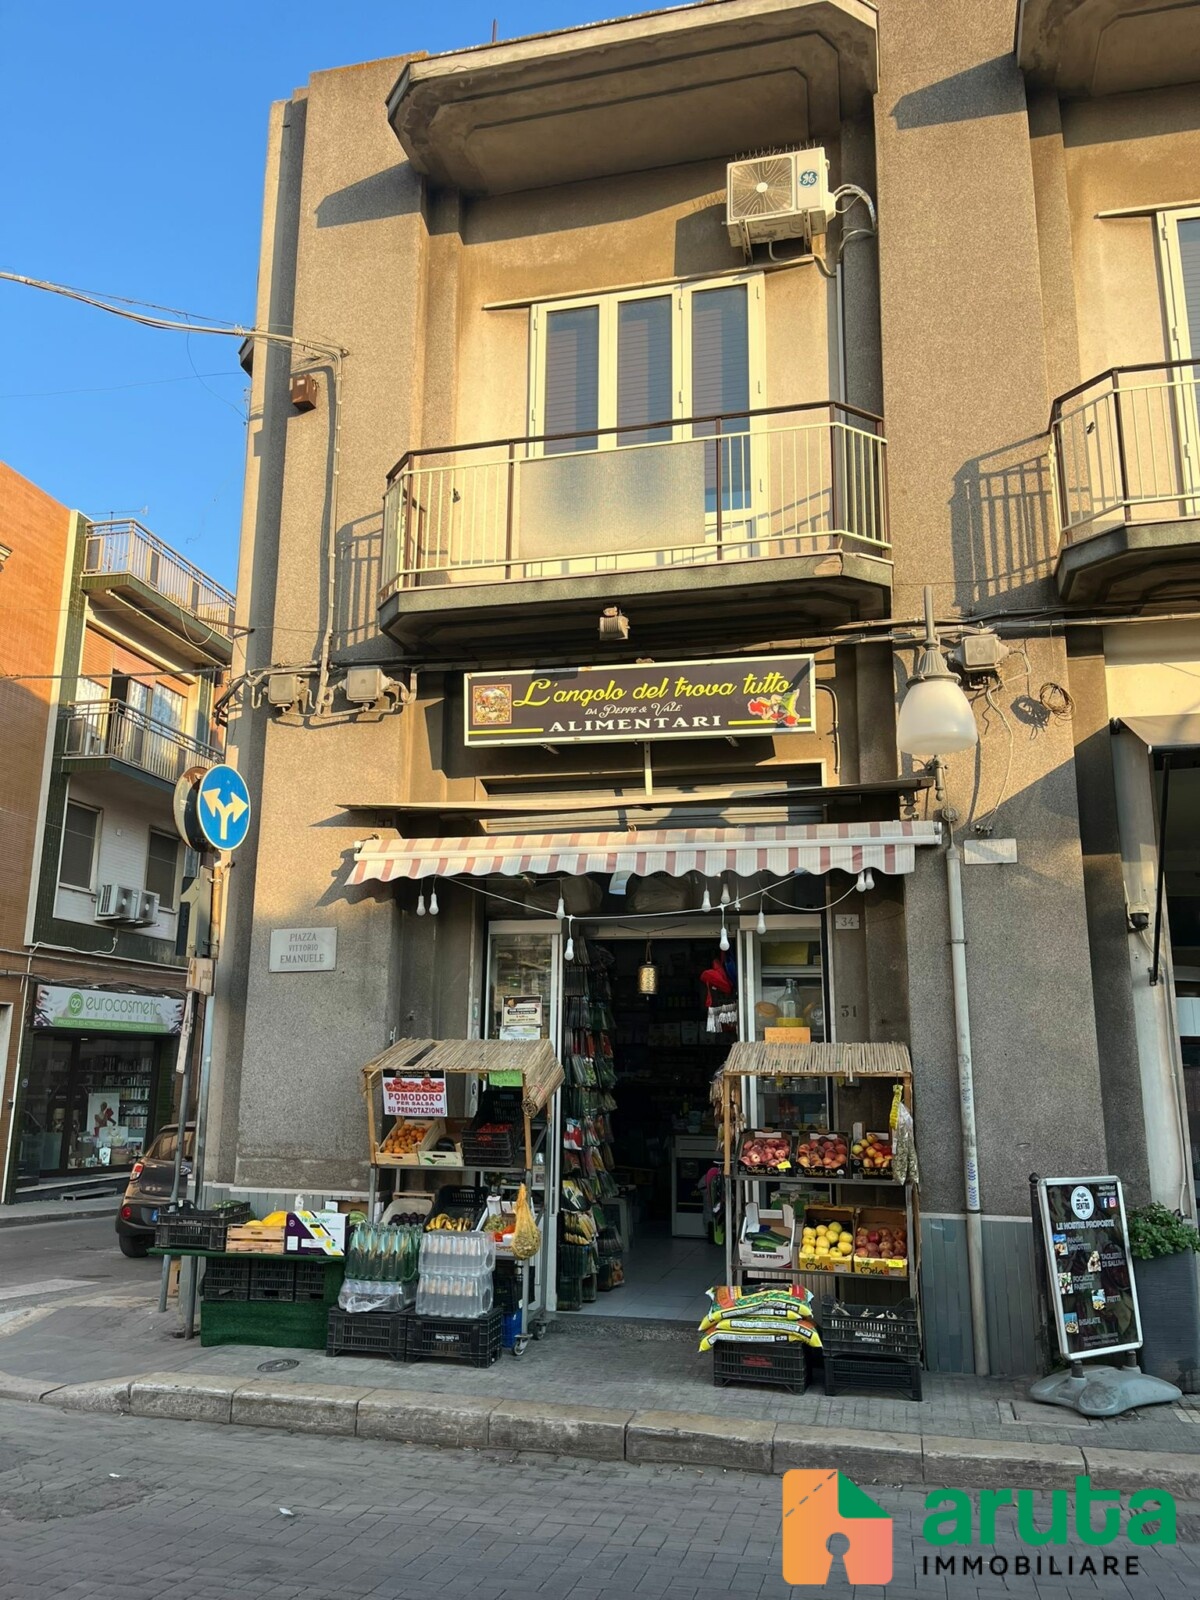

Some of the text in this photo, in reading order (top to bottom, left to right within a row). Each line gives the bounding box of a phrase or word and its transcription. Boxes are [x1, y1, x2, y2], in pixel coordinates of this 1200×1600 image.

[513, 672, 792, 706] L'angolo del trova tutto
[549, 716, 722, 732] ALIMENTARI
[841, 917, 854, 926] 34
[290, 932, 317, 942] PIAZZA
[288, 944, 318, 952] VITTORIO
[280, 954, 324, 964] EMANUELE
[86, 996, 161, 1016] eurocosmetic
[388, 1093, 442, 1102] POMODORO
[1086, 1220, 1115, 1229] PROPOSTE
[806, 1262, 828, 1271] Mela
[860, 1266, 883, 1275] Mela
